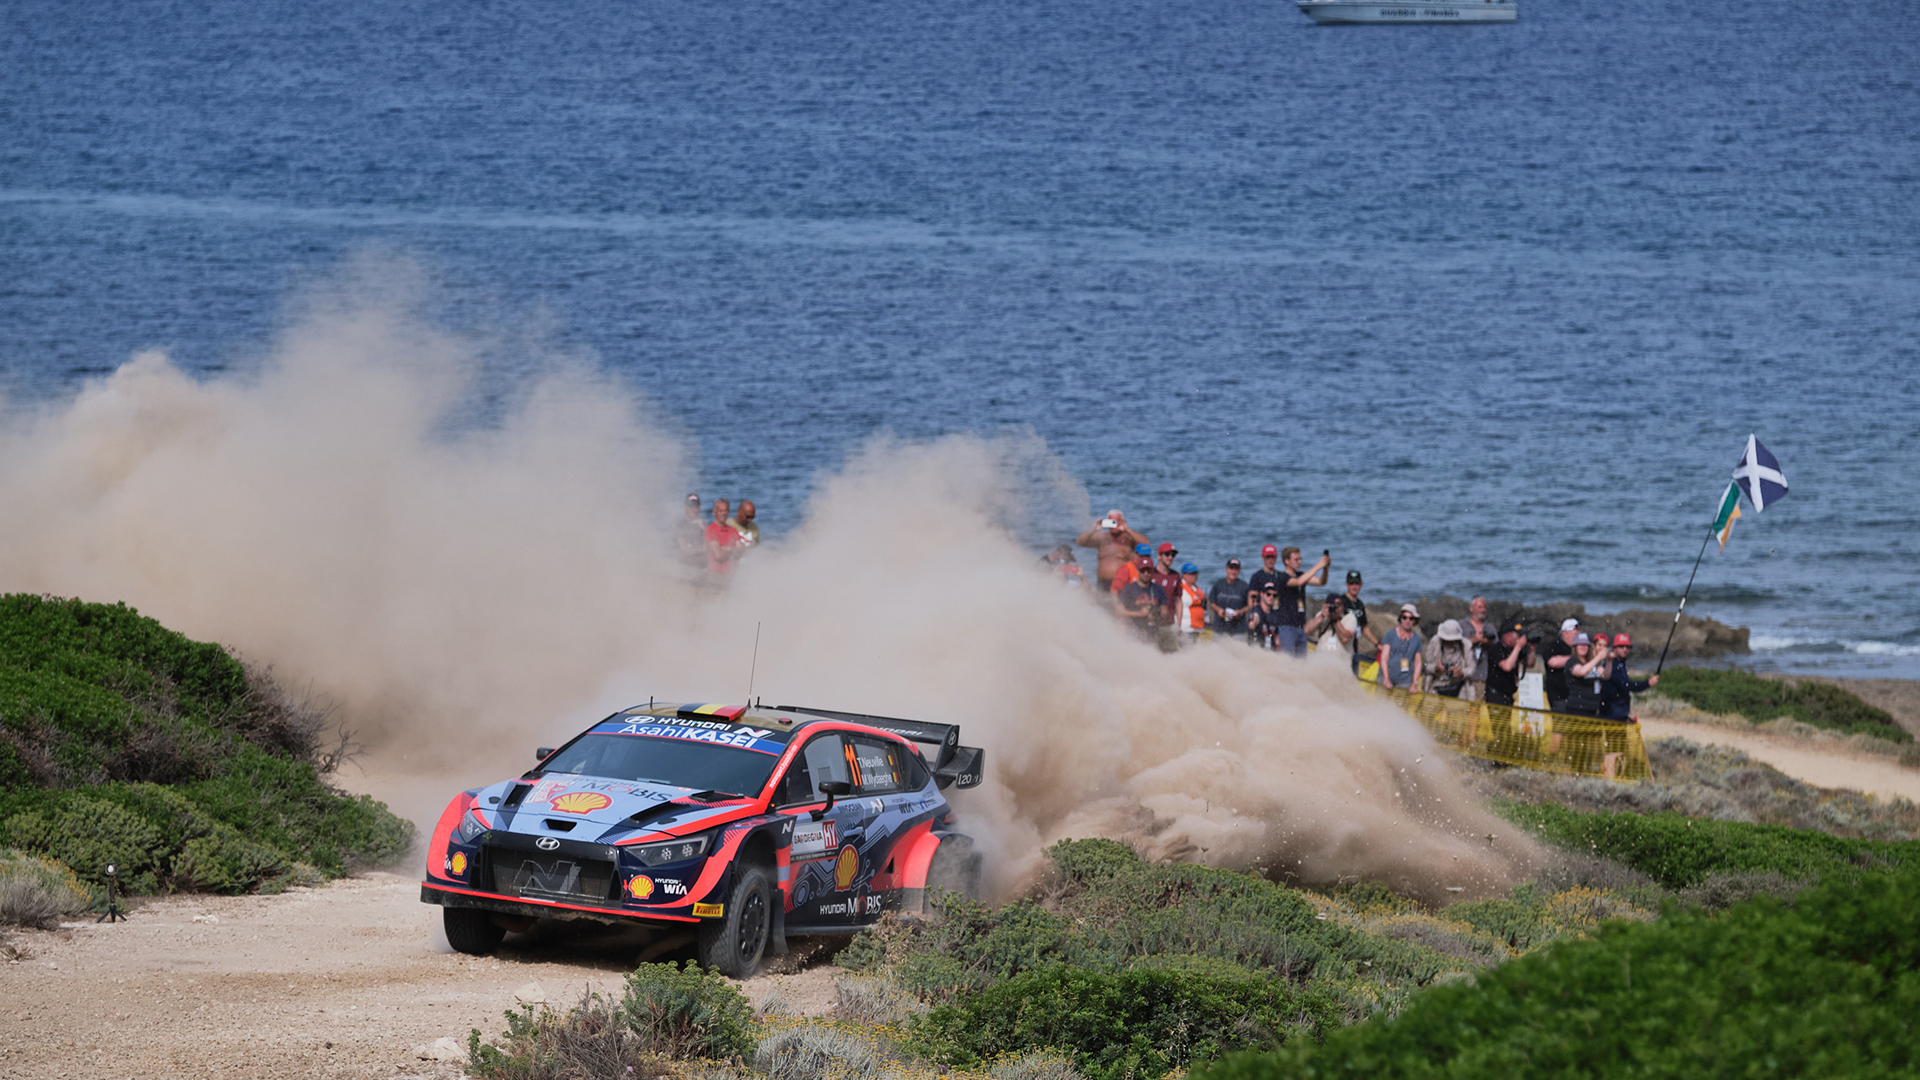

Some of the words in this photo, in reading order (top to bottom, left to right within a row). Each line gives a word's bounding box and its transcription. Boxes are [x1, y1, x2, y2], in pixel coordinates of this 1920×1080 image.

[657, 717, 732, 732] HYUNDAI
[581, 782, 673, 802] MOBIS
[793, 831, 823, 845] SARDEGNA
[823, 824, 836, 847] HY
[663, 883, 688, 895] WIA
[695, 905, 721, 915] PIRELLI
[819, 903, 847, 915] HYUNDAI
[846, 895, 882, 916] MOBIS
